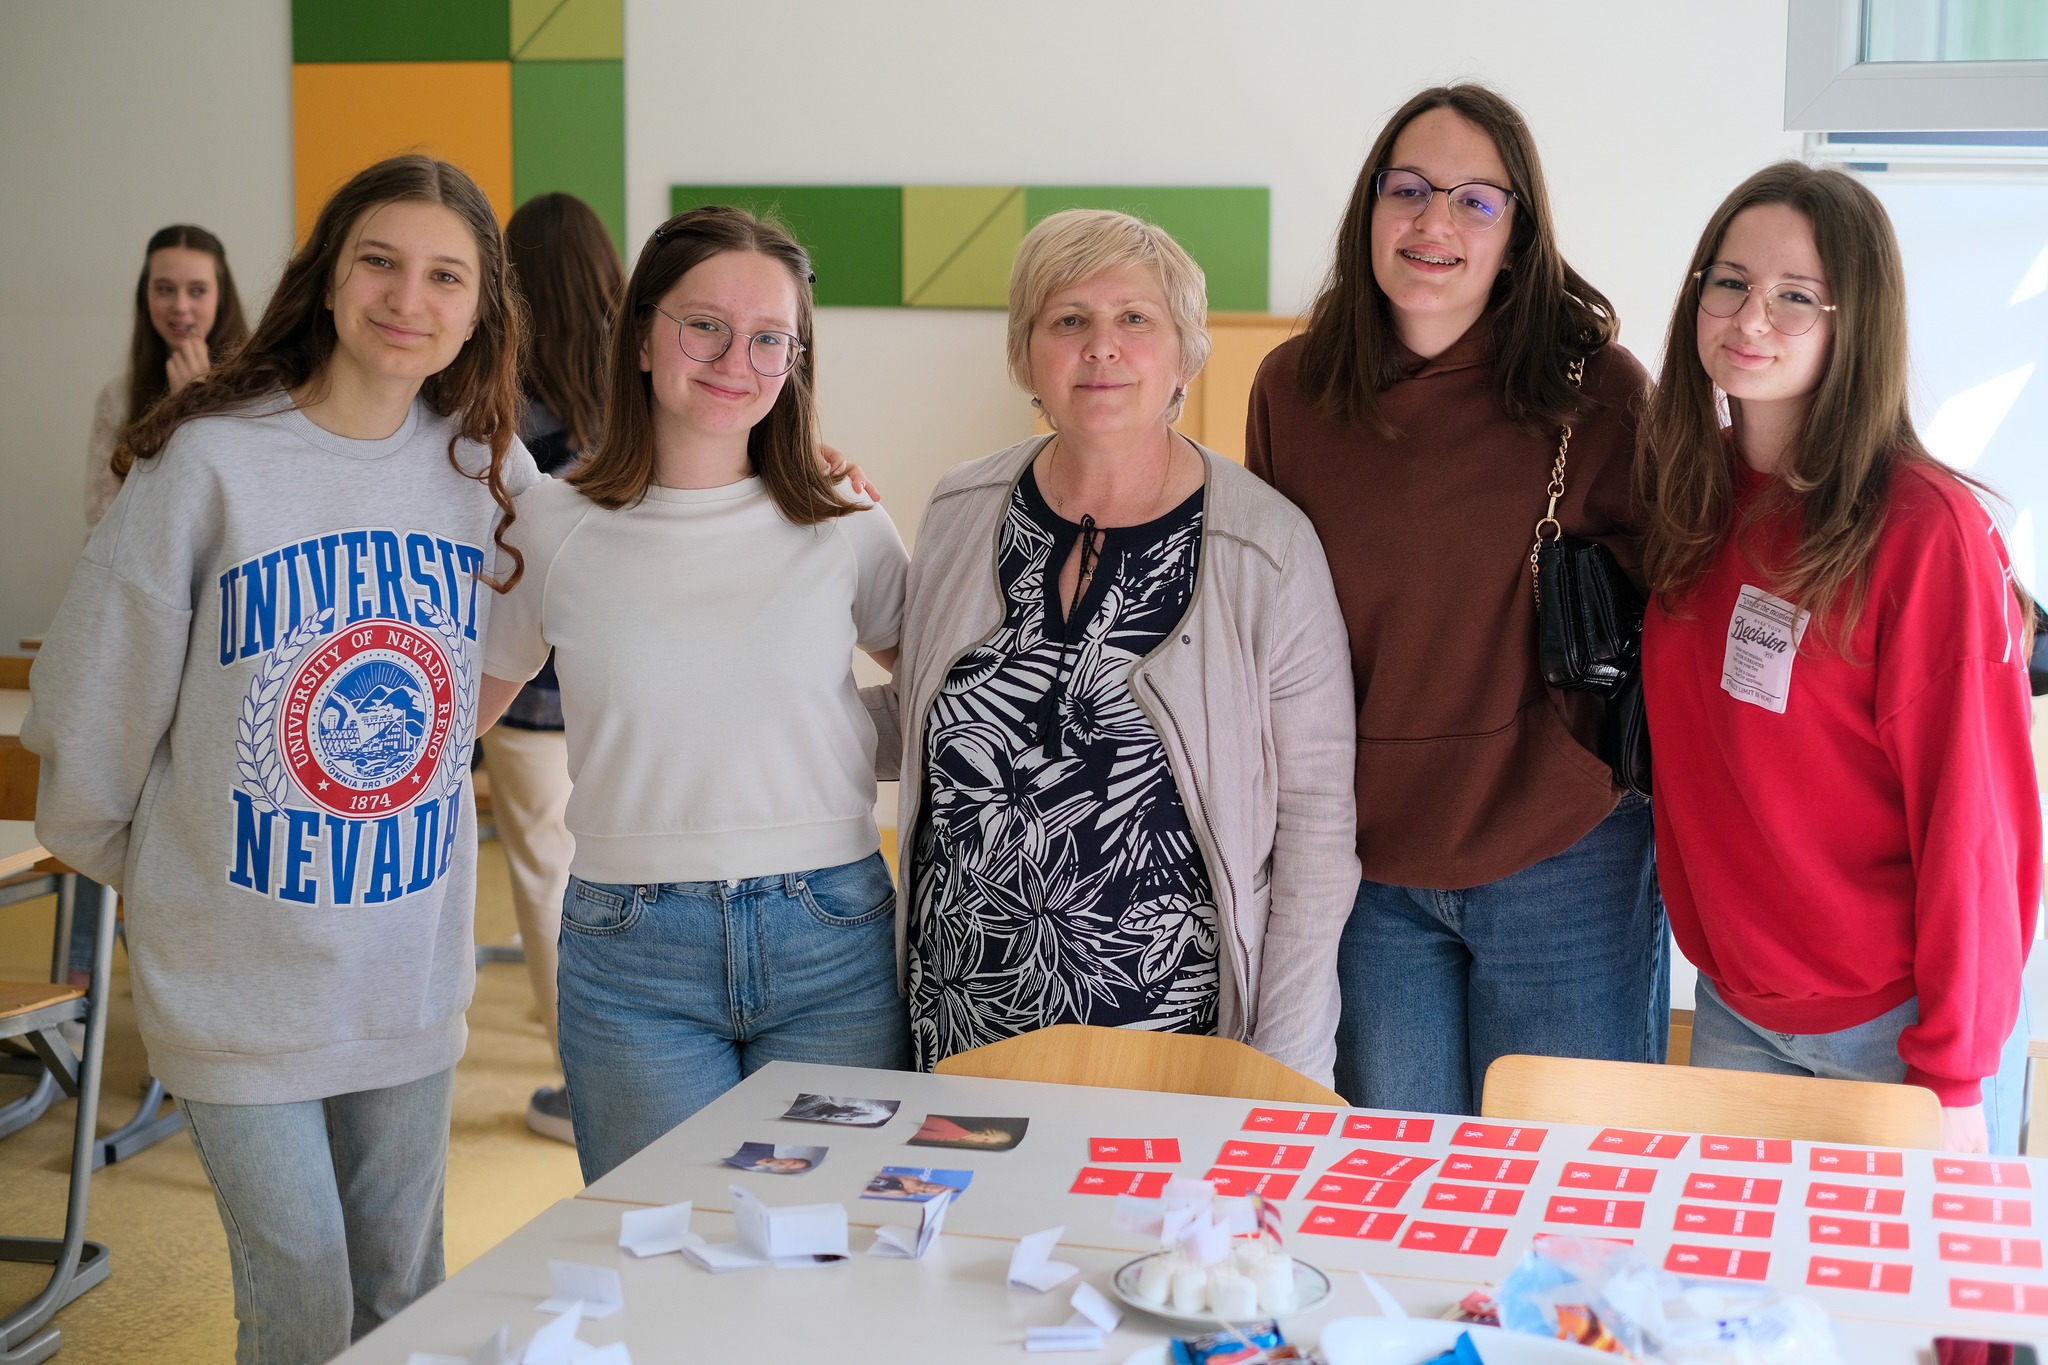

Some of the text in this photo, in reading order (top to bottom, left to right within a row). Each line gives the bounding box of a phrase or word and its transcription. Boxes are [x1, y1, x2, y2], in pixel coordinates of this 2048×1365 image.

[217, 529, 485, 666] UNIVERSIT
[1760, 603, 1770, 613] the
[1770, 608, 1794, 623] momen
[1730, 615, 1788, 654] Decision
[1767, 624, 1782, 633] YOUR
[288, 629, 450, 769] UNIVERSITY OF NEVADA RENO
[328, 761, 415, 789] OMNIA PRO PATRIA
[348, 793, 392, 810] 1874
[229, 782, 462, 905] NEVADA
